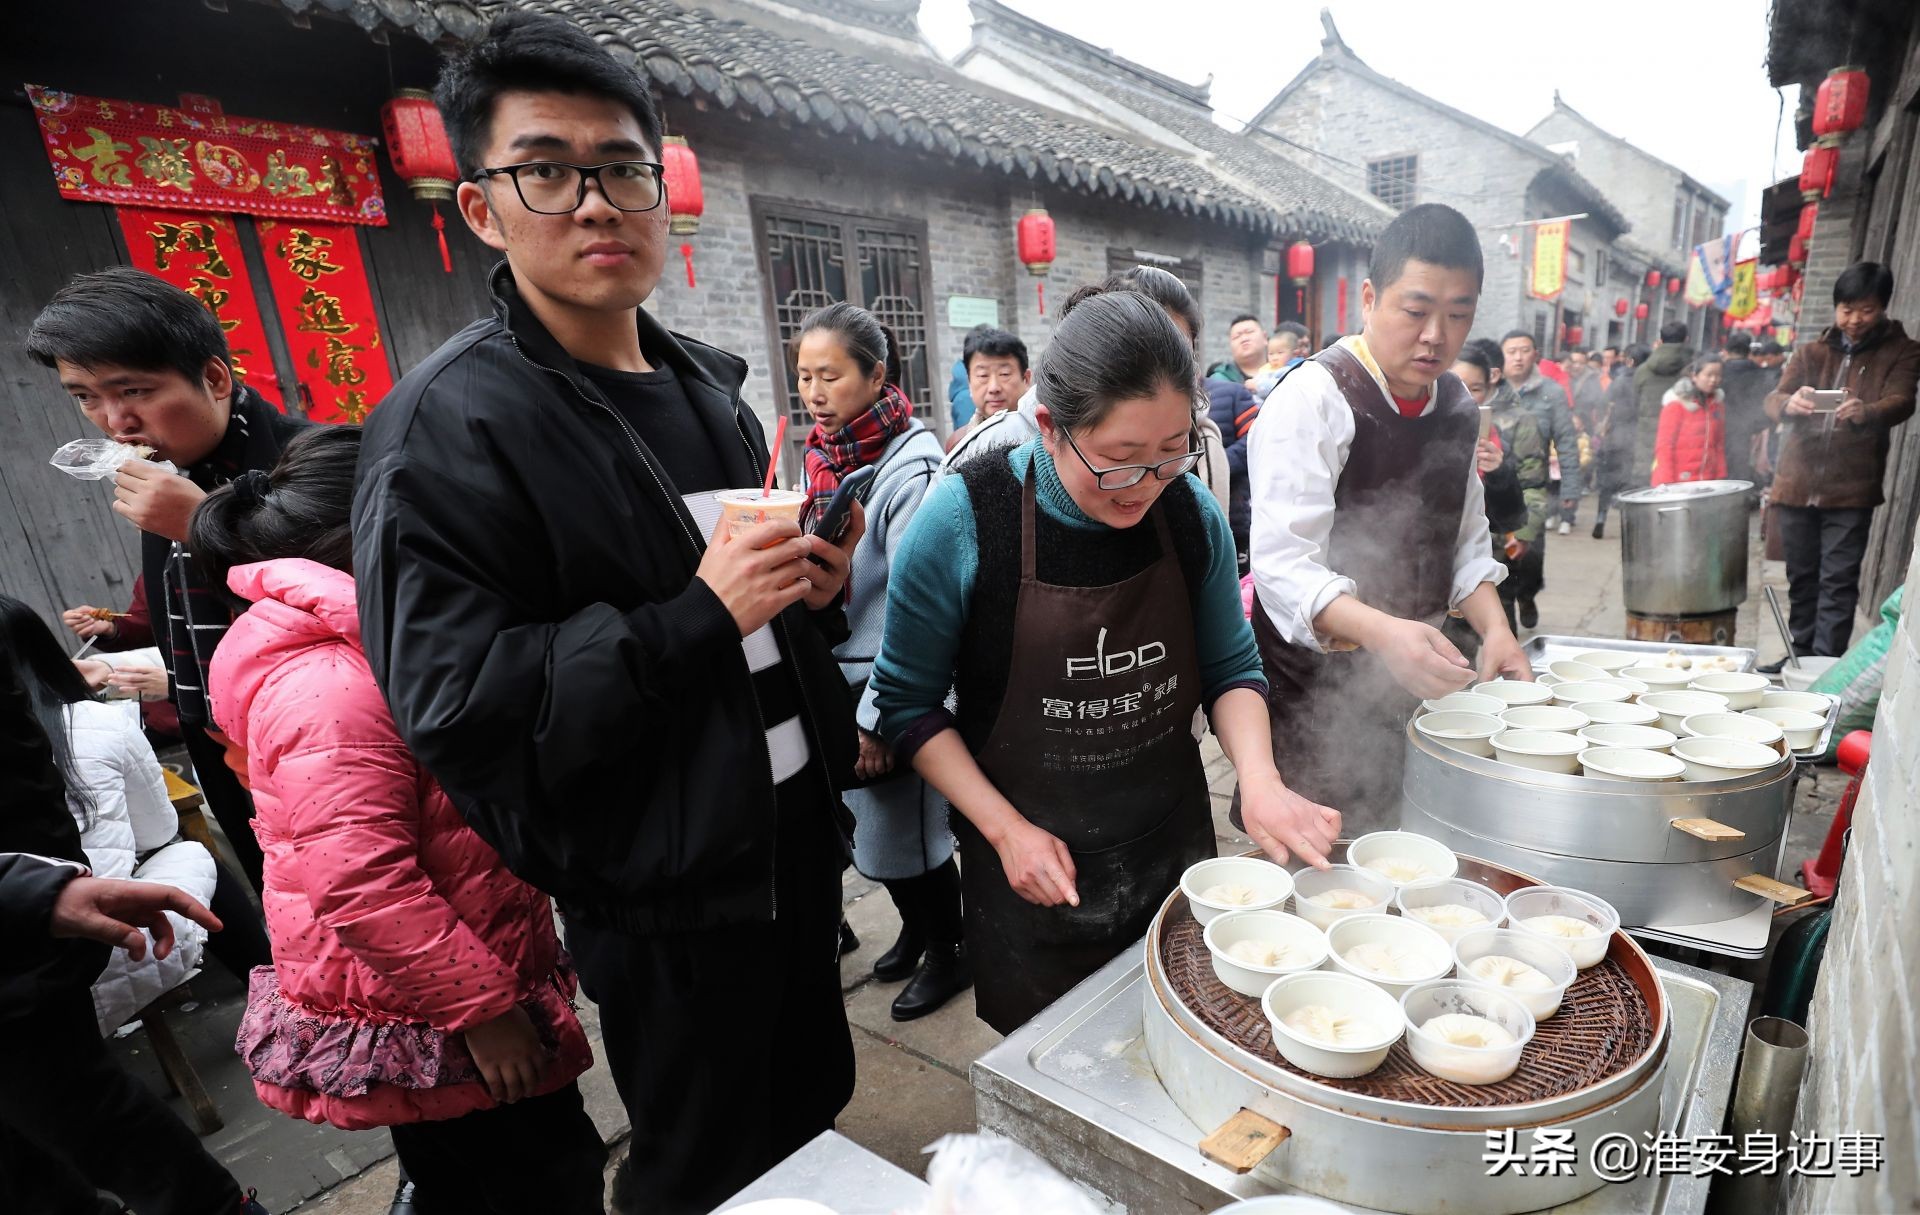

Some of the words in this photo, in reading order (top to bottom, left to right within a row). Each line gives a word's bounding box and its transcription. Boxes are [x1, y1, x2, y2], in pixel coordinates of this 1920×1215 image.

[1042, 691, 1143, 720] 富得宝
[1153, 674, 1178, 702] 家具
